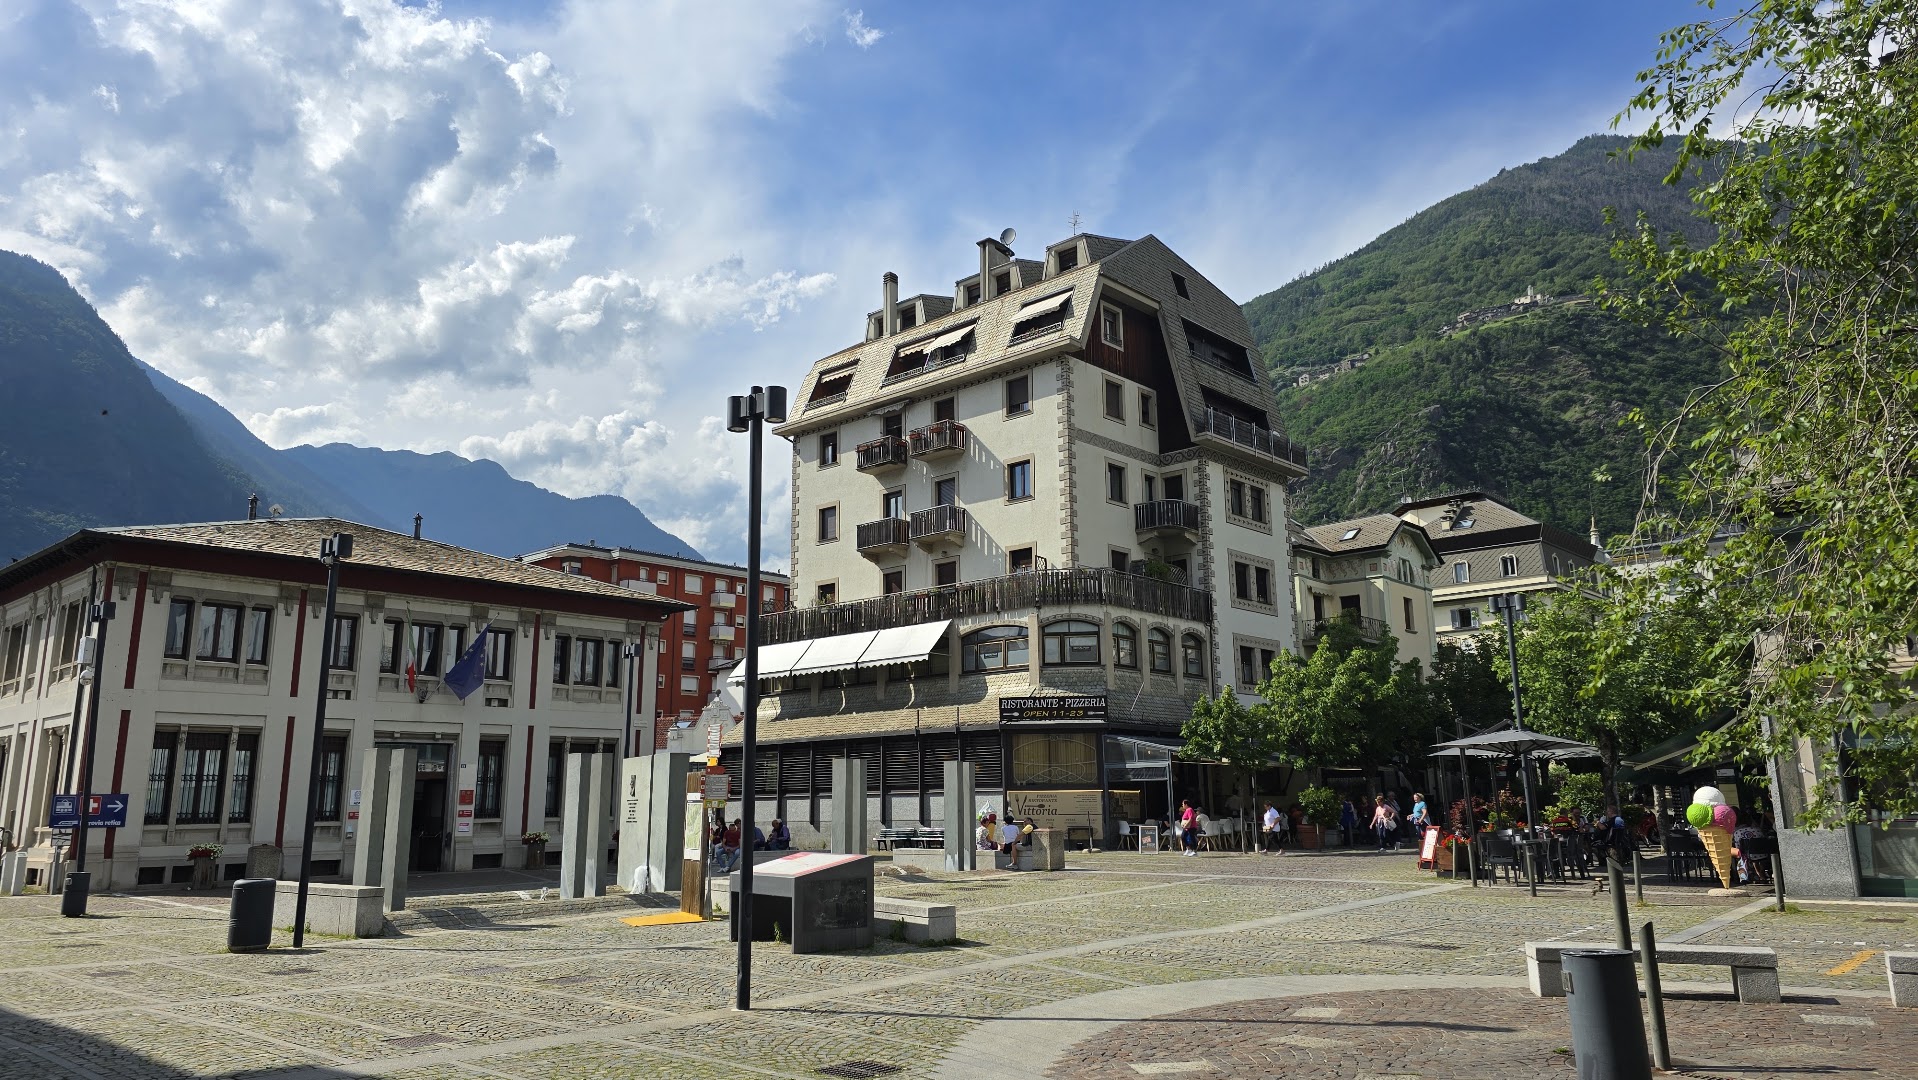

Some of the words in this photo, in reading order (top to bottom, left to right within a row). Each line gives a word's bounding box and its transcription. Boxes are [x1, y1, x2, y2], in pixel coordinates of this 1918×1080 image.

[1001, 699, 1058, 708] RISTORANTE
[1065, 698, 1105, 707] PIZZERIA
[1015, 794, 1057, 815] Vittoria
